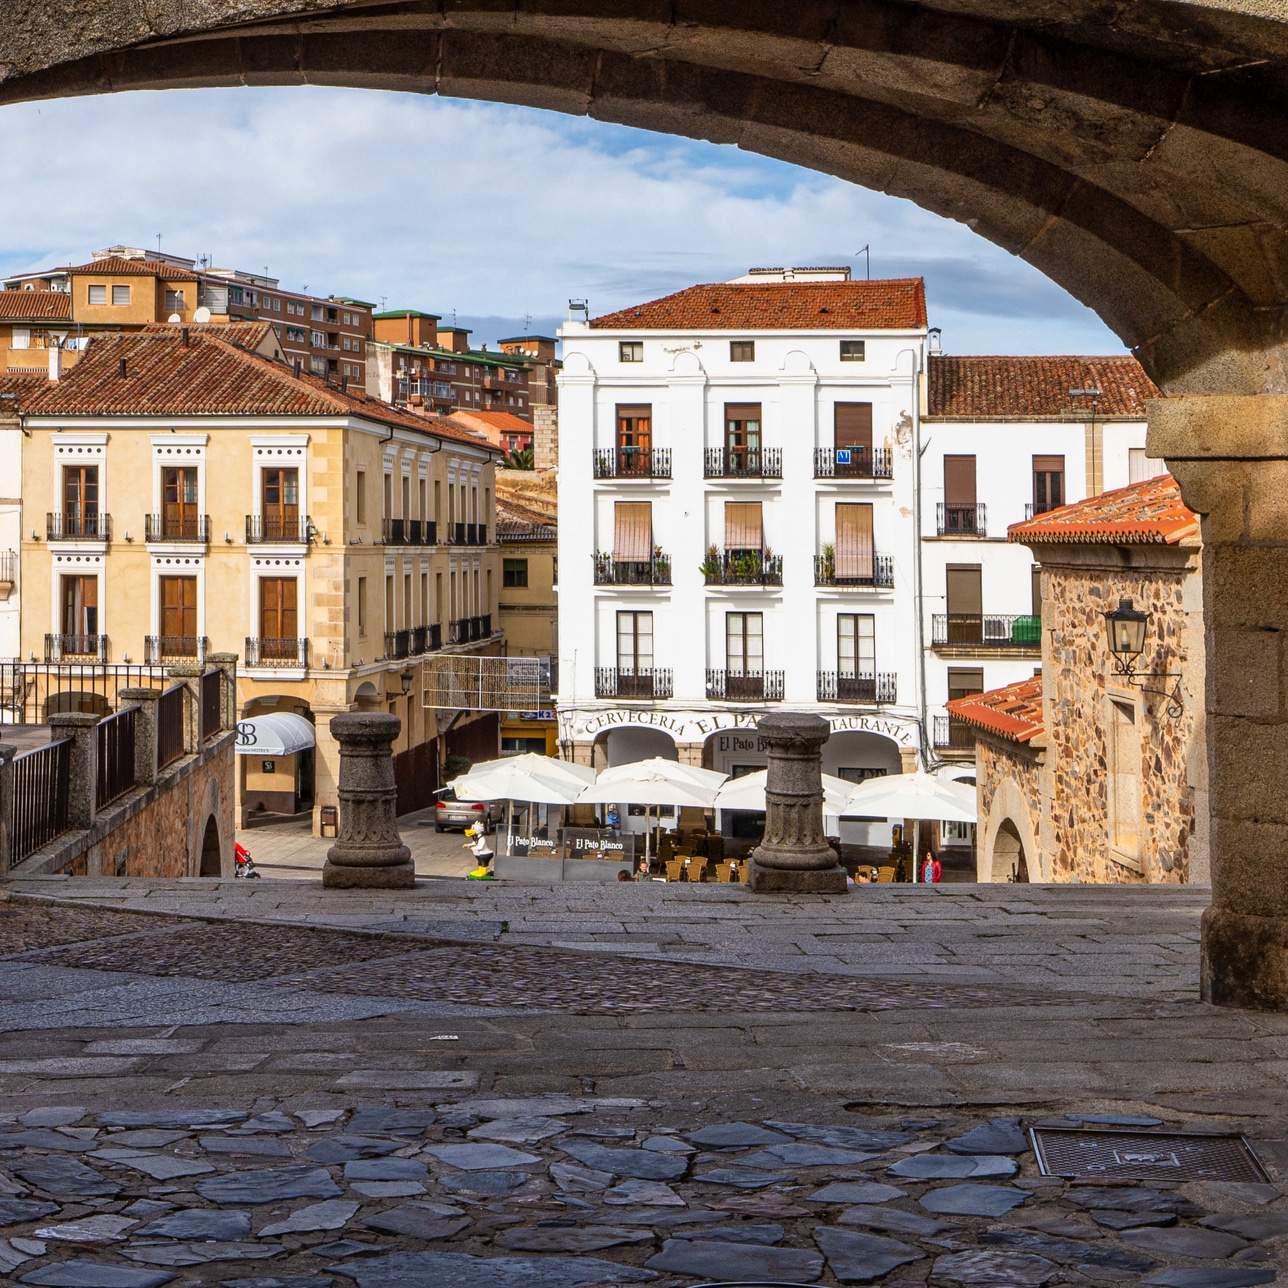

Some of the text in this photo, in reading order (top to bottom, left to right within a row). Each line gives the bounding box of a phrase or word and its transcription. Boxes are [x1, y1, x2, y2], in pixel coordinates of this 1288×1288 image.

[585, 710, 686, 736] CERVECERIA
[829, 717, 913, 745] TAURANTE
[719, 736, 729, 751] El
[733, 737, 754, 751] Pato
[515, 836, 529, 847] Pato
[531, 837, 553, 847] Blanco
[576, 838, 623, 851] El Pato Blanco
